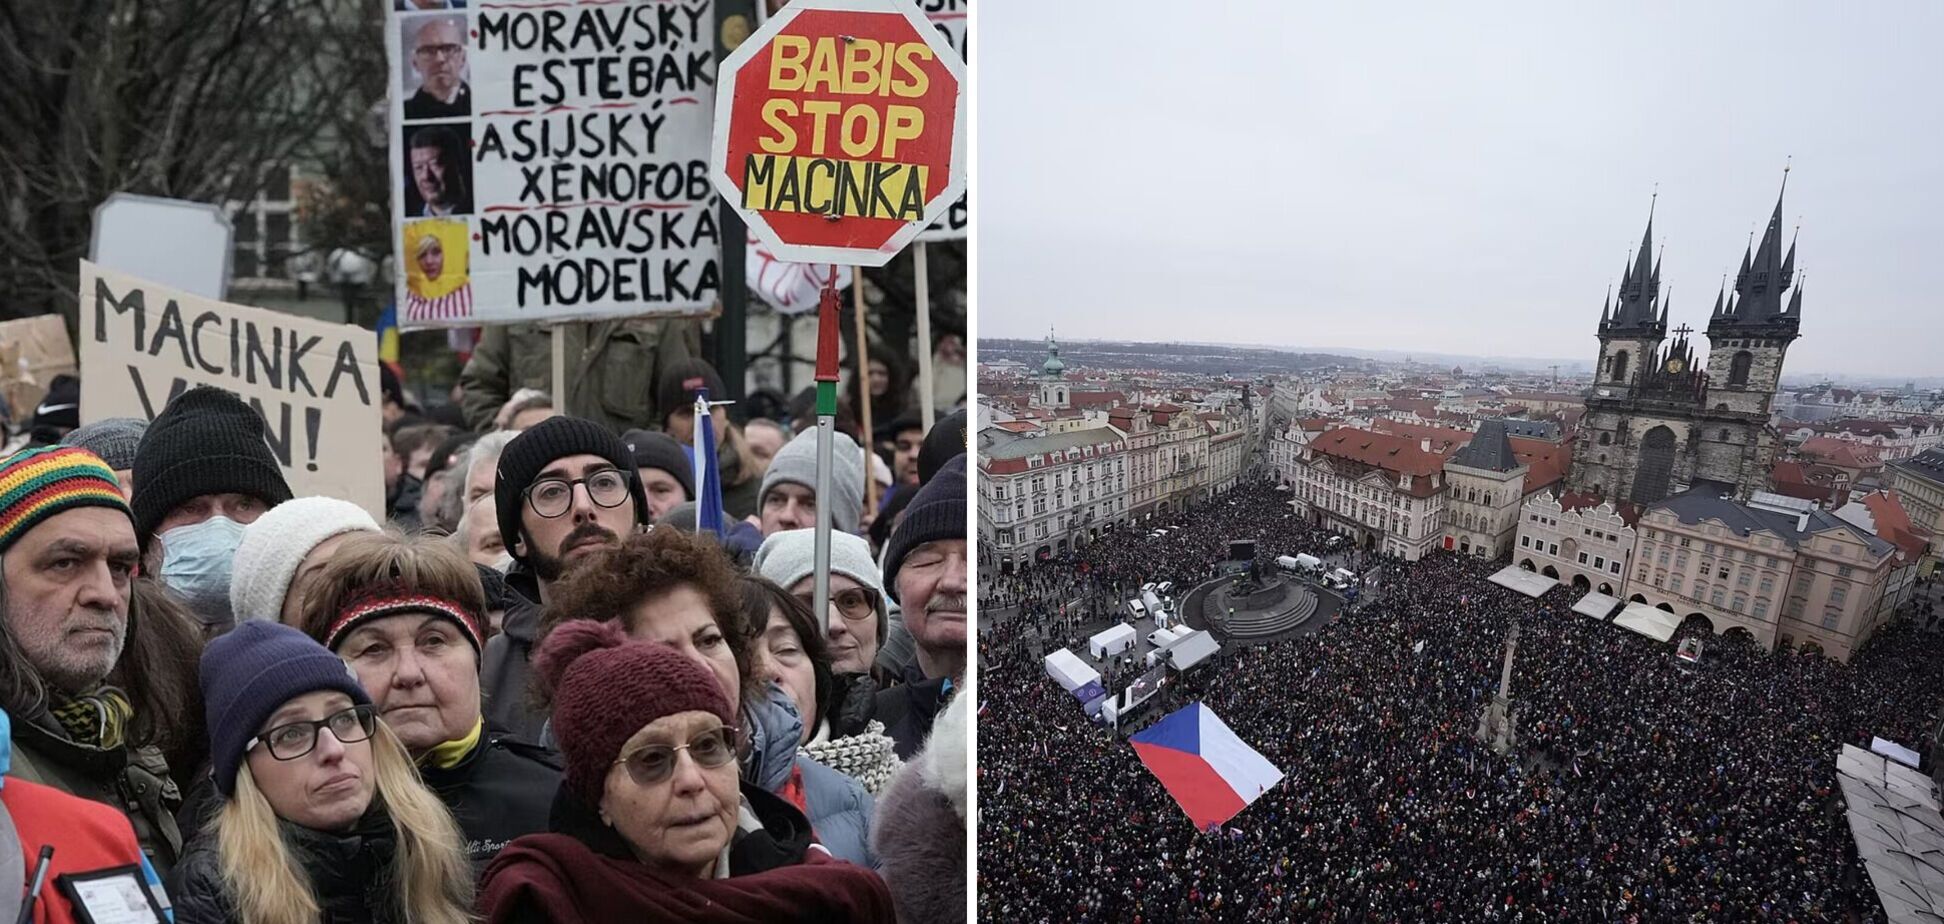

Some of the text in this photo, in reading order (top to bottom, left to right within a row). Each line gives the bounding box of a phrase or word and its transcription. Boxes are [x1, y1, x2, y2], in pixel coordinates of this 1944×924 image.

[513, 41, 715, 107] ESTÉBÁK
[768, 35, 933, 98] BABIS
[477, 98, 666, 162] ASIJSKÝ
[758, 98, 925, 158] STOP
[741, 154, 924, 221] MACINKA
[481, 194, 718, 255] MORAVSKÁ
[517, 257, 721, 308] MODELKA
[95, 277, 371, 406] MACINKA
[127, 364, 322, 472] VN!
